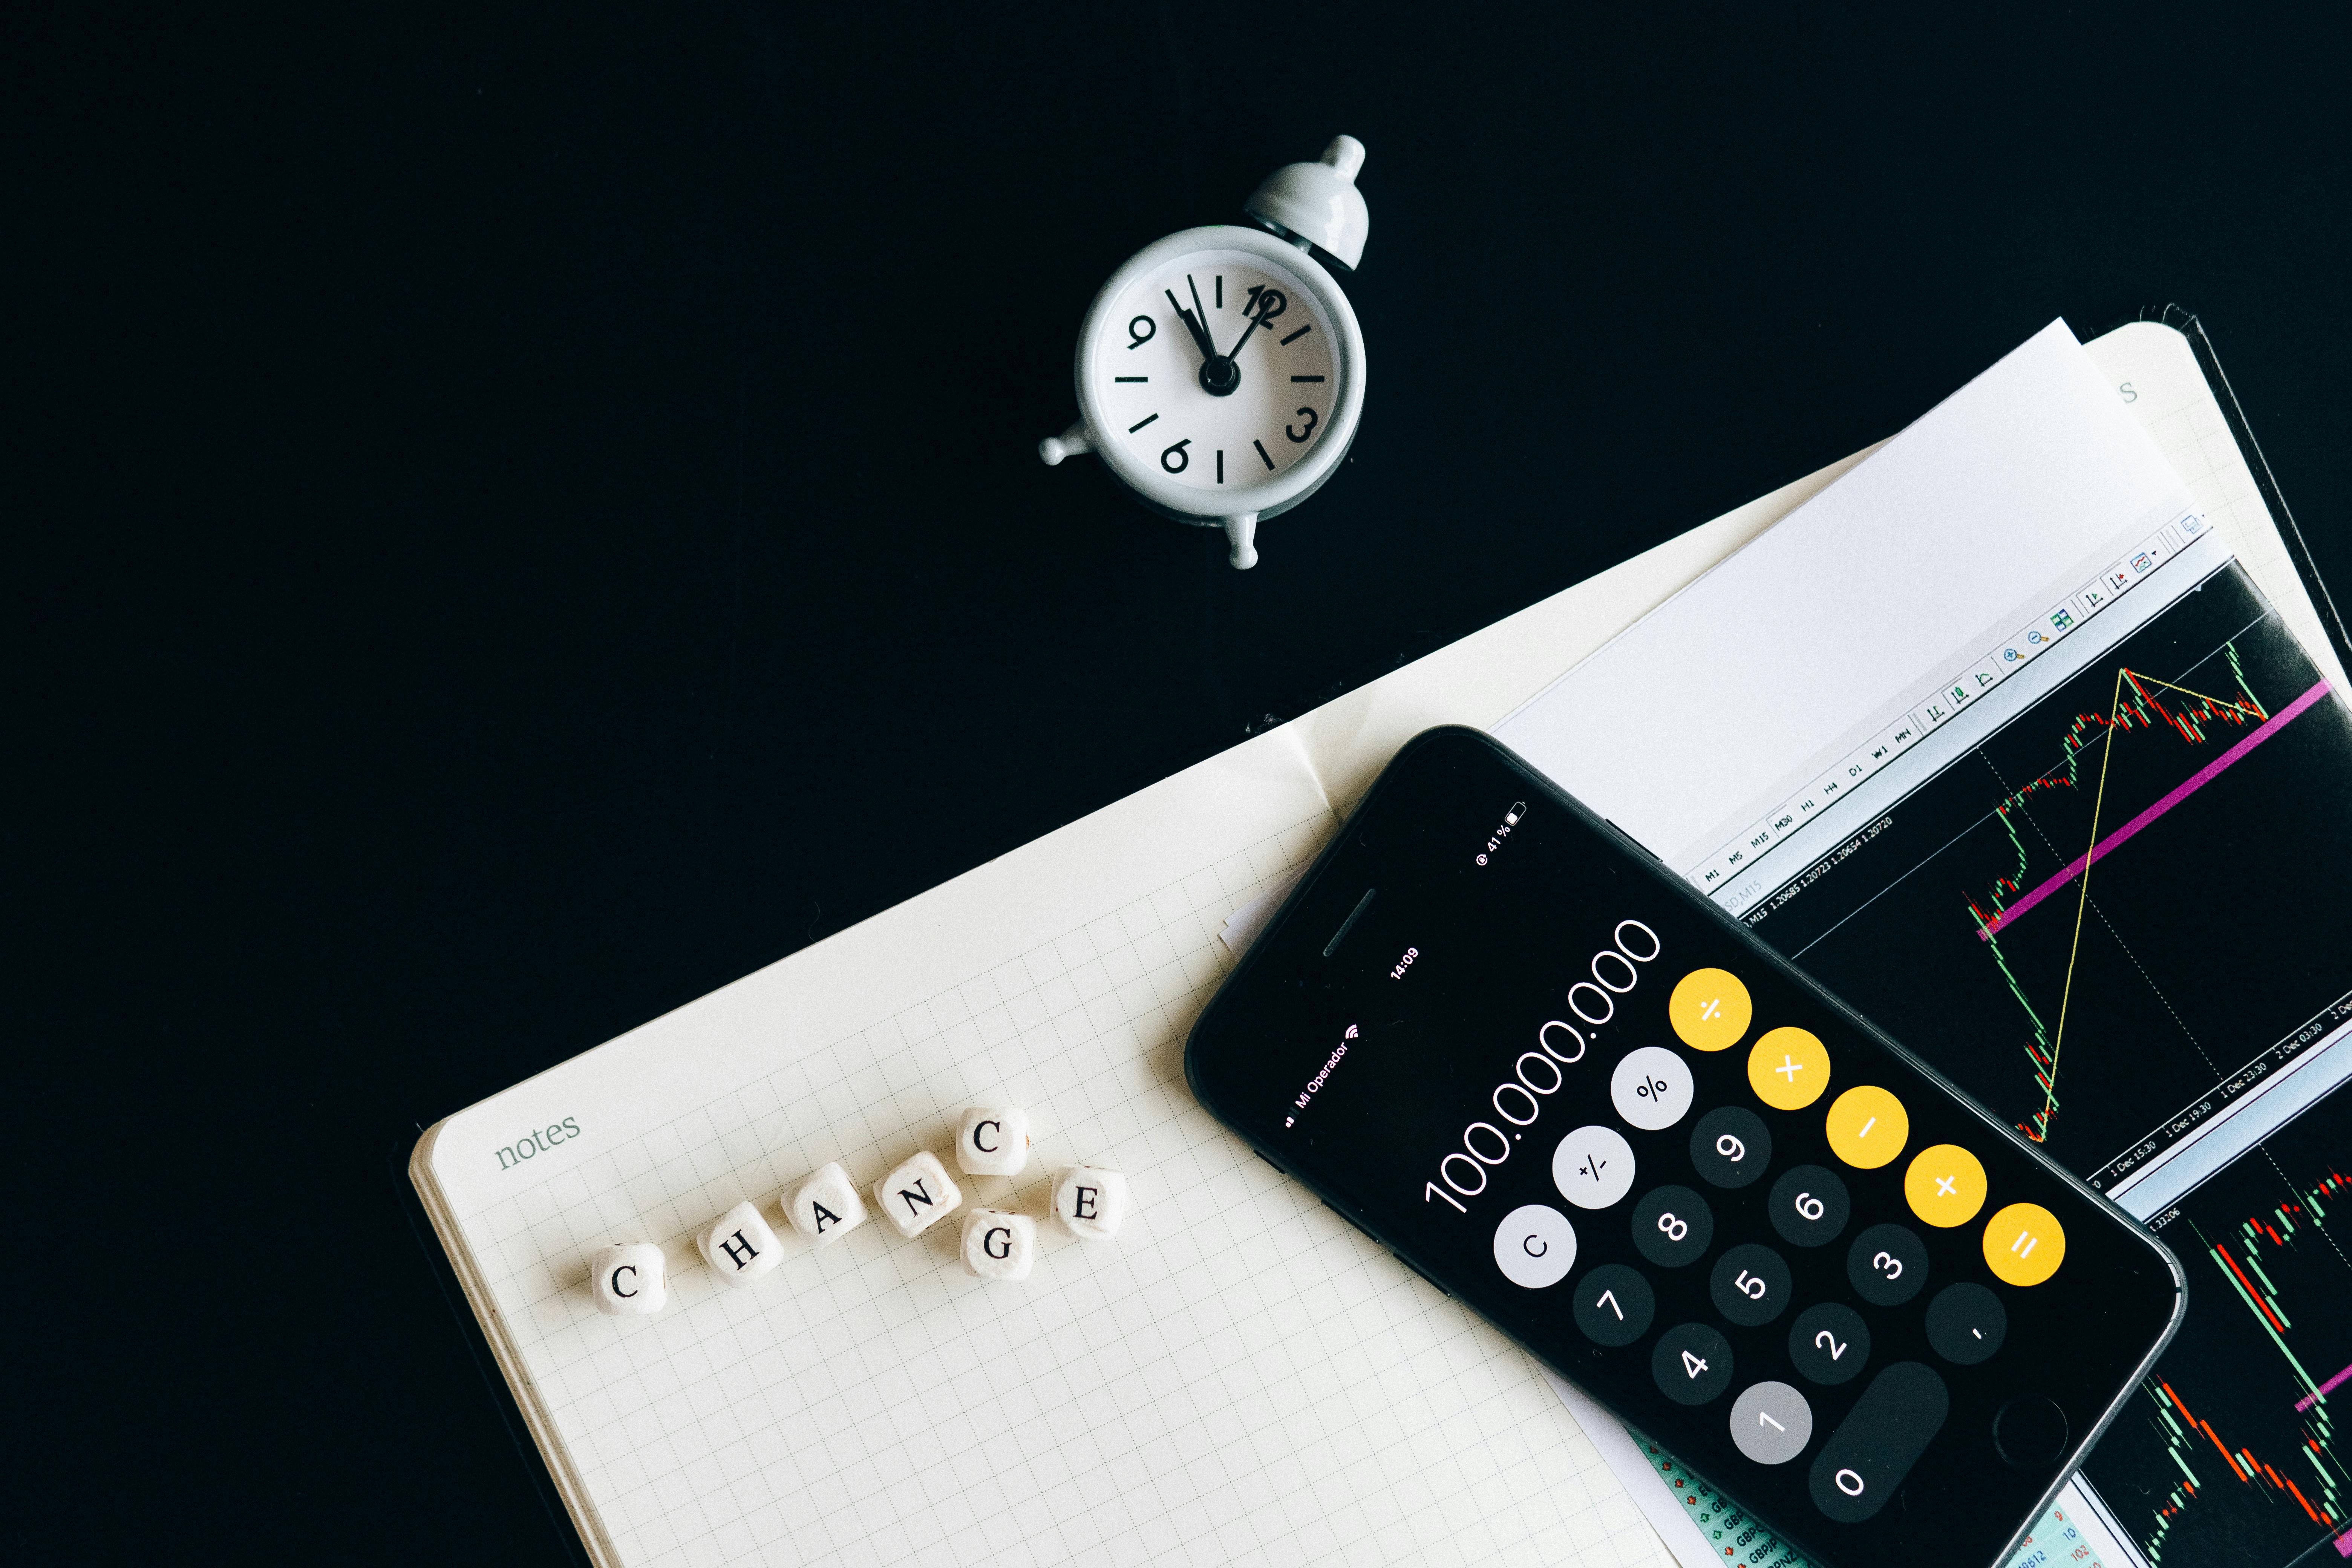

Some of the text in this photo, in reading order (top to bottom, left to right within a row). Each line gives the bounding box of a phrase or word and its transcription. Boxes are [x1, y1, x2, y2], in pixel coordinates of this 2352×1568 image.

[1243, 284, 1288, 330] 12
[1127, 315, 1156, 349] 9
[1285, 407, 1318, 443] 3
[1161, 439, 1192, 474] 6
[1487, 825, 1510, 852] 41 %
[1705, 869, 1720, 882] M1
[1729, 851, 1743, 865] M5
[1751, 832, 1769, 848] M15
[1775, 815, 1793, 831] M30
[1801, 800, 1815, 812] H1
[1848, 765, 1862, 776] D1
[1801, 861, 1831, 887] 1.20723
[1723, 880, 1762, 911] SD,M15
[1390, 947, 1419, 980] 14:09
[2331, 1011, 2339, 1020] 2
[2275, 1023, 2322, 1059] 2 Dec 03:30
[1295, 1041, 1348, 1109] Mi Operador
[1426, 920, 1660, 1213] 100.000.000
[2227, 1080, 2245, 1093] Dec
[2243, 1063, 2266, 1082] 23:30
[2172, 1118, 2190, 1133] Dec
[2189, 1102, 2211, 1121] 19:30
[495, 1116, 580, 1170] notes
[2117, 1158, 2134, 1172] Dec
[2134, 1141, 2156, 1160] 15:30
[1523, 1234, 1547, 1258] C
[1637, 1075, 1667, 1102] %
[611, 1120, 1098, 1298] C H A N C E
[983, 1227, 1011, 1259] G
[1596, 1290, 1623, 1320] 7
[1658, 1213, 1687, 1241] 8
[1716, 1135, 1745, 1162] 9
[1681, 1350, 1708, 1379] 4
[1735, 1269, 1766, 1299] 5
[1795, 1193, 1824, 1220] 6
[1759, 1412, 1785, 1432] 1
[1815, 1331, 1847, 1360] 2
[1873, 1252, 1902, 1279] 3
[1835, 1469, 1864, 1496] 0
[1724, 1510, 1744, 1530] GBP
[2063, 1528, 2076, 1541] 10
[1749, 1538, 1777, 1564] GBPJP
[2071, 1545, 2089, 1562] 102
